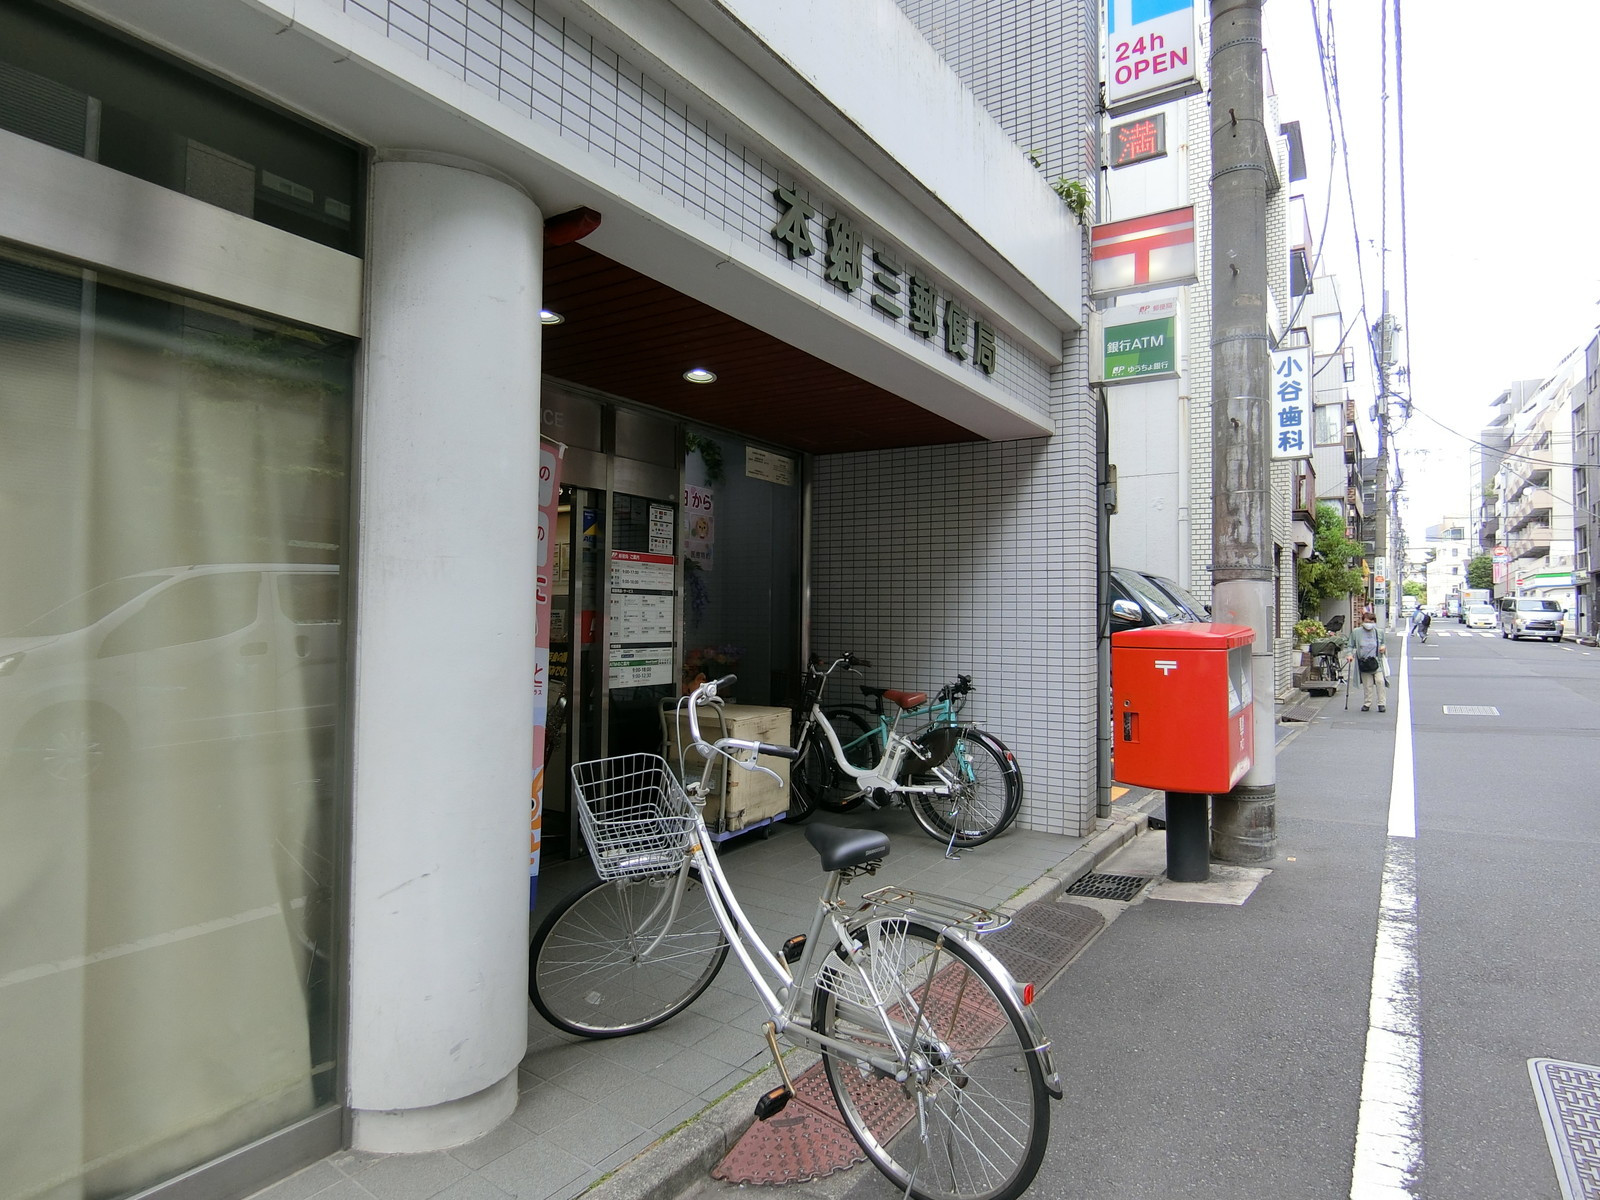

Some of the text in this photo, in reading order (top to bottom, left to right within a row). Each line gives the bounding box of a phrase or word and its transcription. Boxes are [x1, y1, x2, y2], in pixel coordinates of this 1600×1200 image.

[1114, 47, 1188, 86] OPEN
[1115, 33, 1164, 62] 24h
[1118, 119, 1157, 162] 満
[771, 187, 996, 375] 本郷三郵便局
[1106, 334, 1165, 354] 銀行ATM
[1128, 361, 1169, 374] ゆうちょ銀行
[1277, 355, 1305, 453] 小谷歯科
